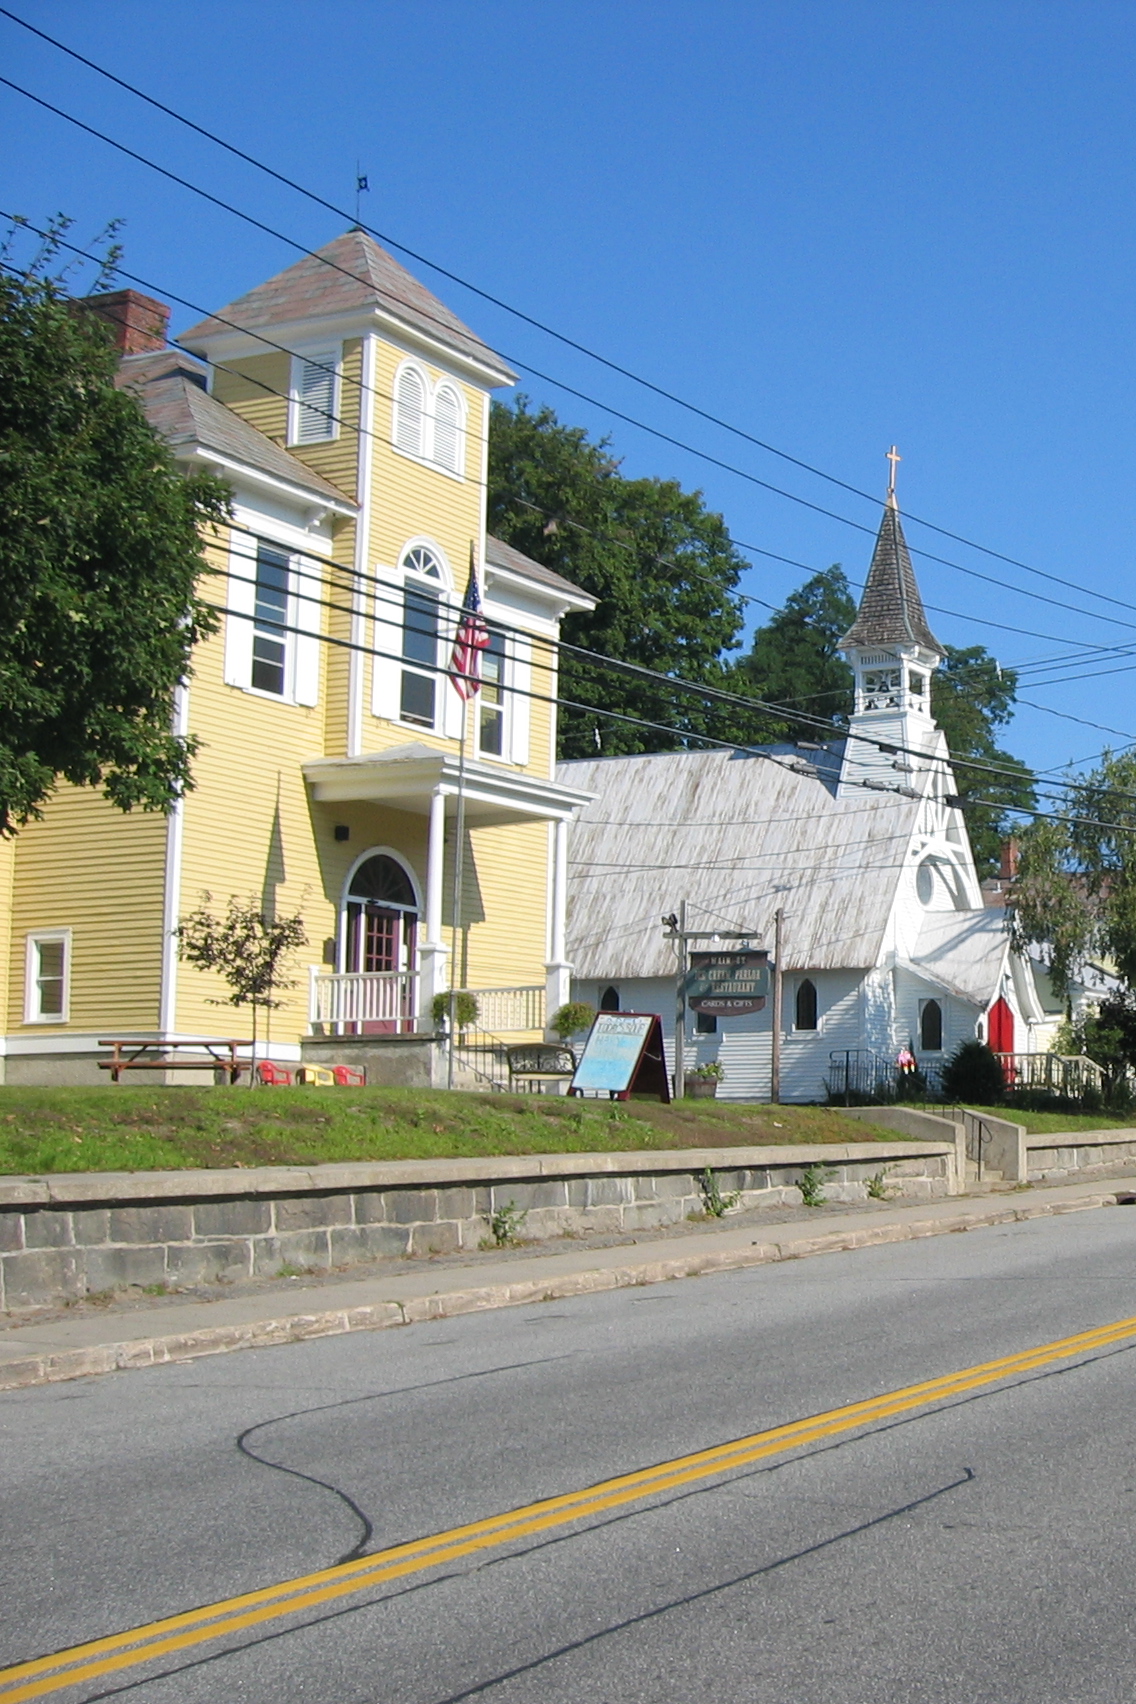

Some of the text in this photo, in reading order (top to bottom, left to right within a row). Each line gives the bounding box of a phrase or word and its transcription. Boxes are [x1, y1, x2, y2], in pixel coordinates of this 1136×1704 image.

[735, 969, 761, 980] PARLOR
[711, 982, 756, 993] RESTAURANT
[701, 1000, 725, 1008] CARDS
